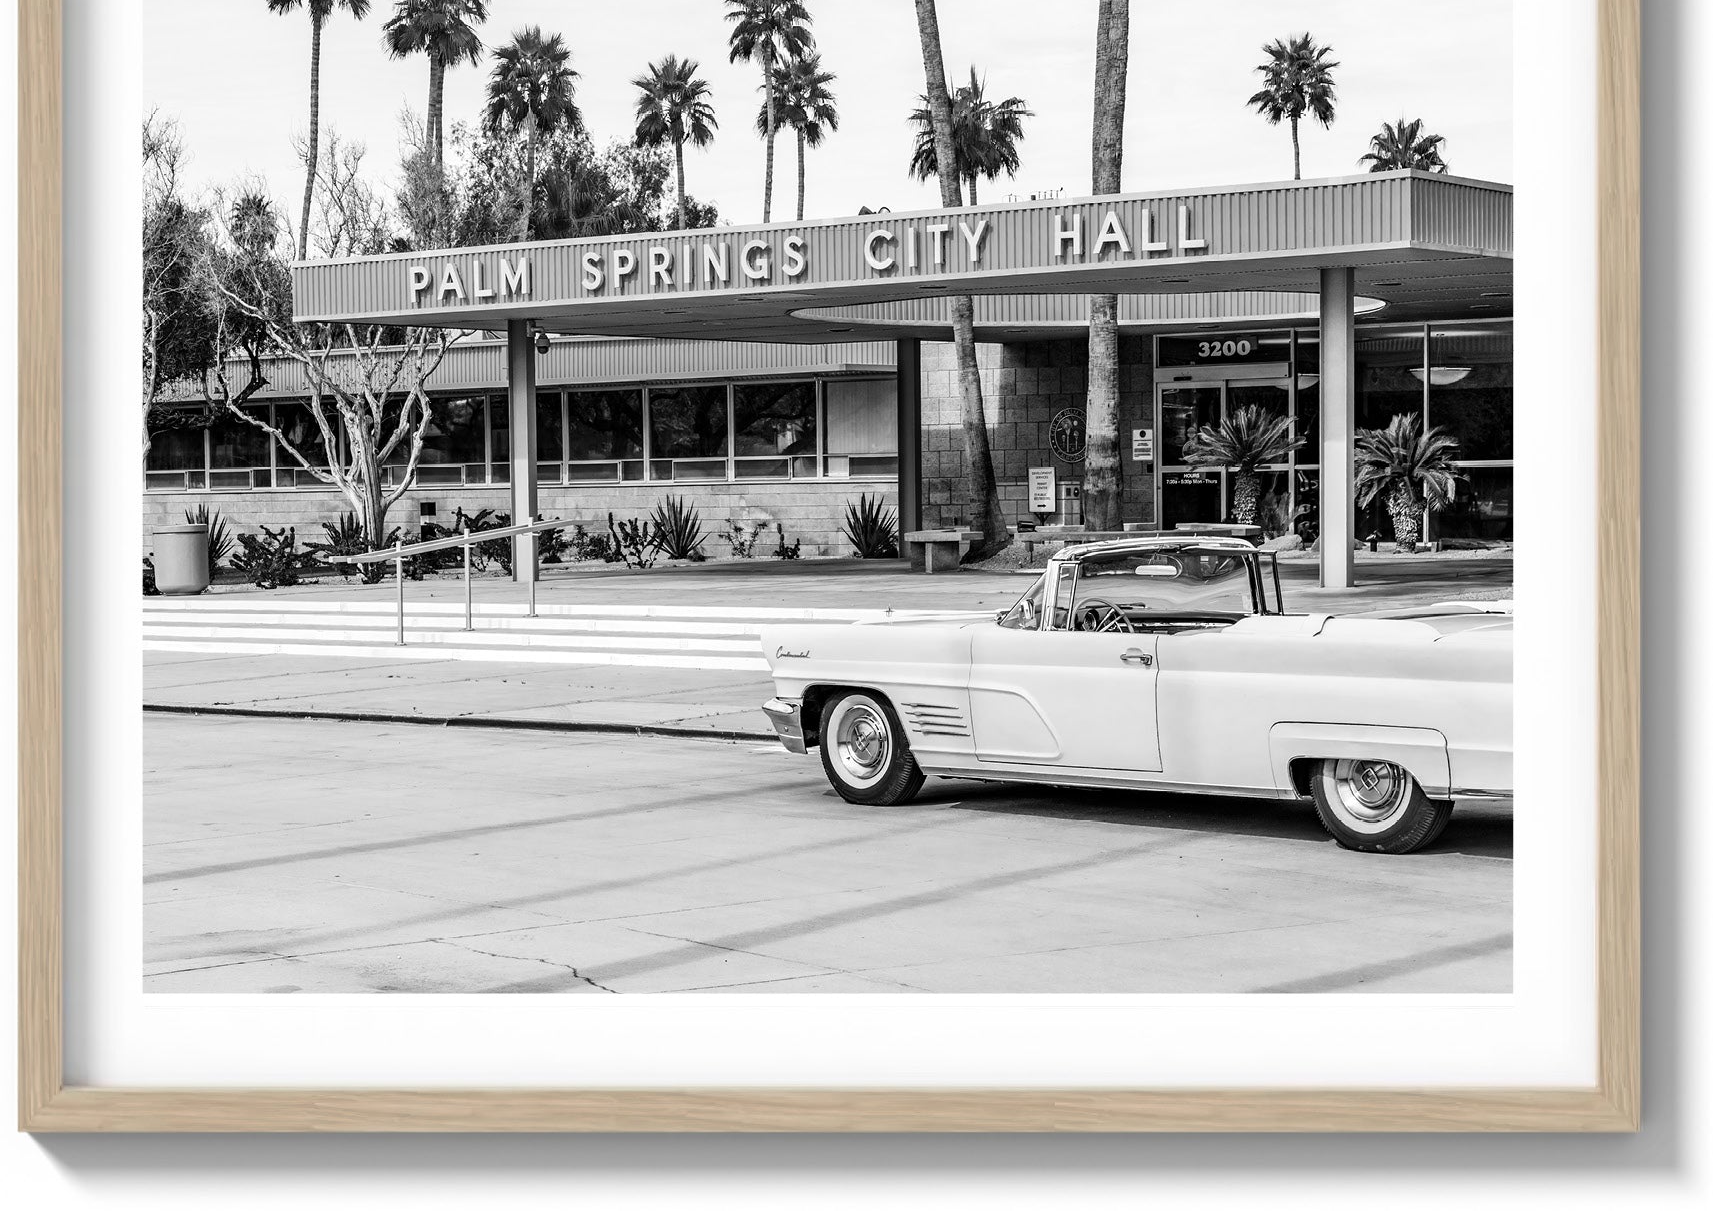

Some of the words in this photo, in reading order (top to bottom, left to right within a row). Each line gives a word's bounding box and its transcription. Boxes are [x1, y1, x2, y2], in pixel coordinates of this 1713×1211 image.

[409, 257, 532, 303] PALM
[581, 235, 807, 291] SPRINGS
[864, 220, 990, 271] CITY
[1053, 205, 1206, 257] HALL
[1198, 340, 1251, 358] 3200
[776, 646, 811, 659] Continental
